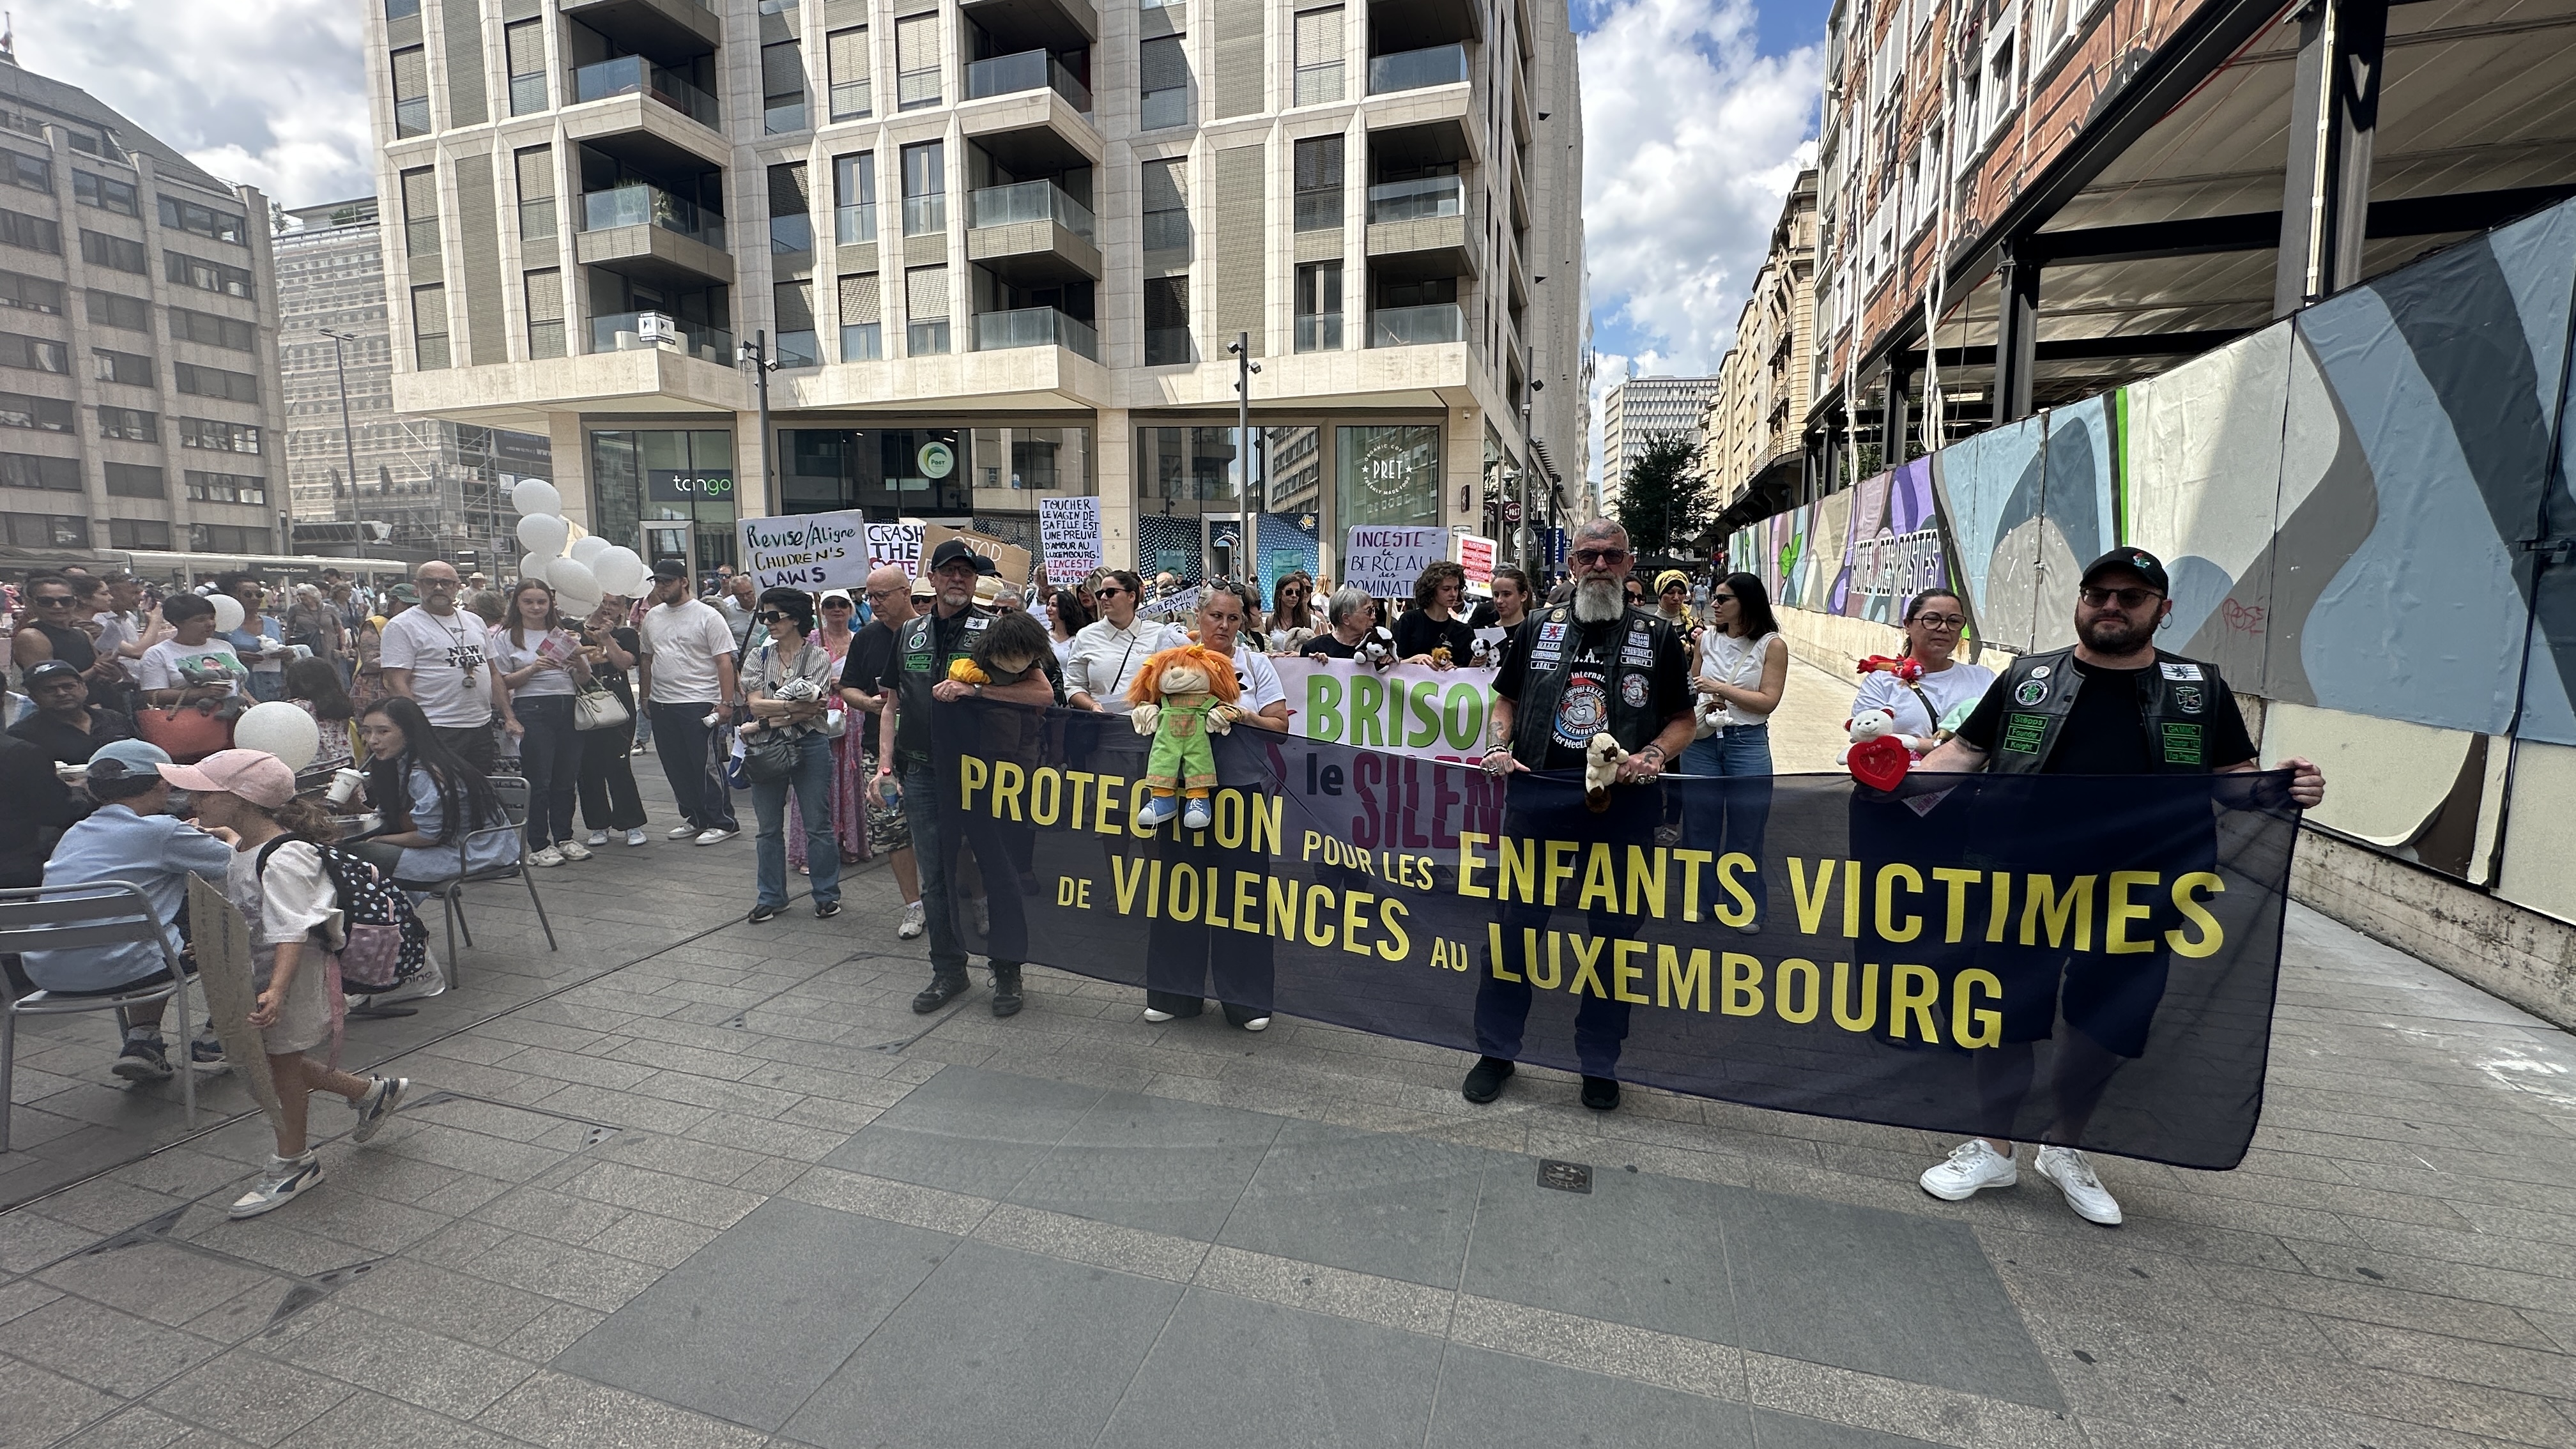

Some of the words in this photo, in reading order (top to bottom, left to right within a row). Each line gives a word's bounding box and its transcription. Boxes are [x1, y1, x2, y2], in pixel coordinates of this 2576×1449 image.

[1373, 459, 1403, 479] PRET
[673, 475, 732, 496] tango
[1042, 499, 1091, 510] TOUCHER
[1053, 511, 1080, 519] VAGIN
[1083, 511, 1094, 521] DE
[868, 525, 924, 543] CRASH
[1045, 531, 1061, 540] UNE
[1064, 530, 1097, 540] PREUVE
[1083, 521, 1100, 531] EST
[1356, 531, 1425, 548] INCESTE
[755, 547, 845, 571] CHILDREN'S
[870, 543, 919, 560] THE
[1876, 536, 1895, 597] DES
[760, 567, 826, 588] LAWS
[1164, 588, 1199, 609] FAMILIA
[447, 645, 479, 657] NEW
[445, 654, 486, 668] YORK
[2011, 741, 2033, 751] Knight
[1307, 753, 1344, 795] le
[1352, 751, 1505, 850] SILEN
[1302, 830, 1376, 876] POUR
[1383, 852, 1435, 891] LES
[1457, 831, 1757, 928] ENFANTS
[1786, 856, 2225, 959] VICTIMES
[1057, 876, 1092, 909] DE
[1112, 854, 1410, 962] VIOLENCES
[1430, 937, 1469, 972] AU
[1488, 922, 2002, 1050] LUXEMBOURG
